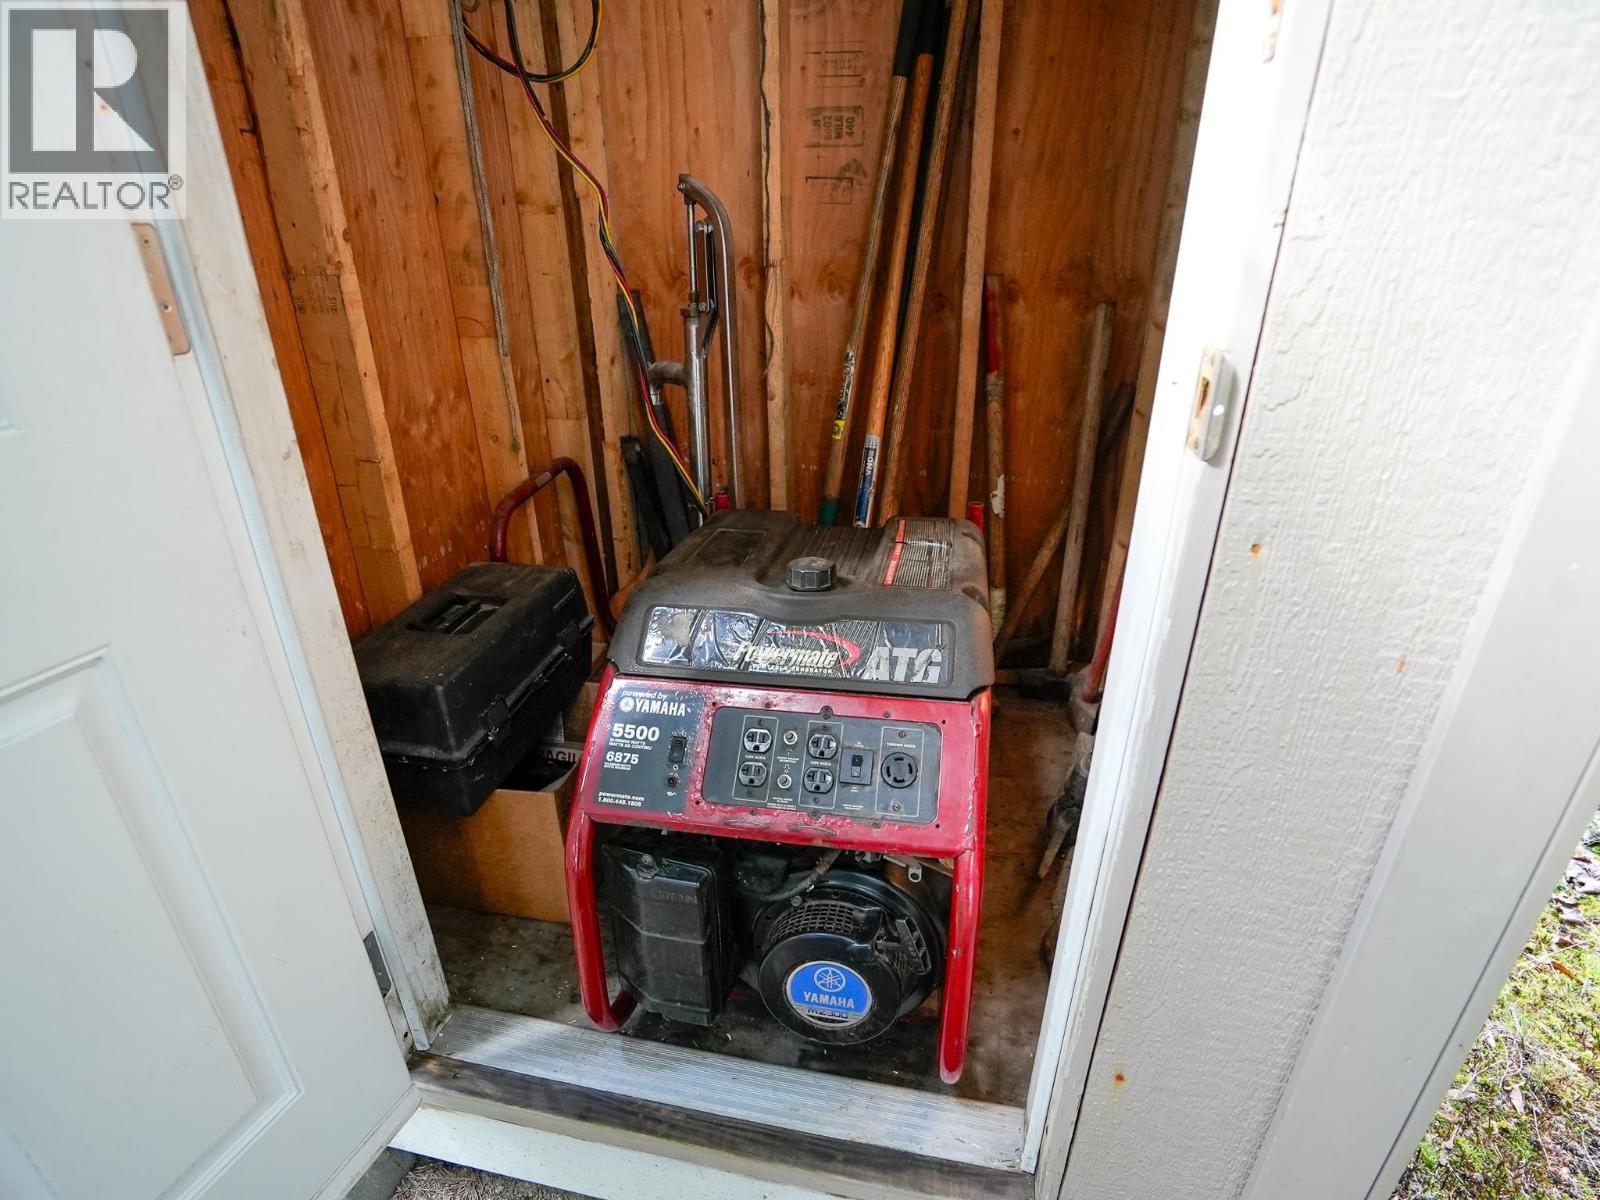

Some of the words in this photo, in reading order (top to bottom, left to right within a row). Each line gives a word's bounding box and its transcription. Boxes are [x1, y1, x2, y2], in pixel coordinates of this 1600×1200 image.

[865, 449, 875, 476] RONA
[734, 641, 839, 668] Powermate
[790, 664, 833, 674] GENERATOR
[863, 646, 943, 683] ATG
[622, 689, 657, 699] powered
[657, 692, 668, 701] by
[635, 699, 686, 717] YAMAHA
[612, 723, 660, 742] 5500
[606, 751, 639, 764] 6875
[803, 991, 855, 1009] YAMAHA
